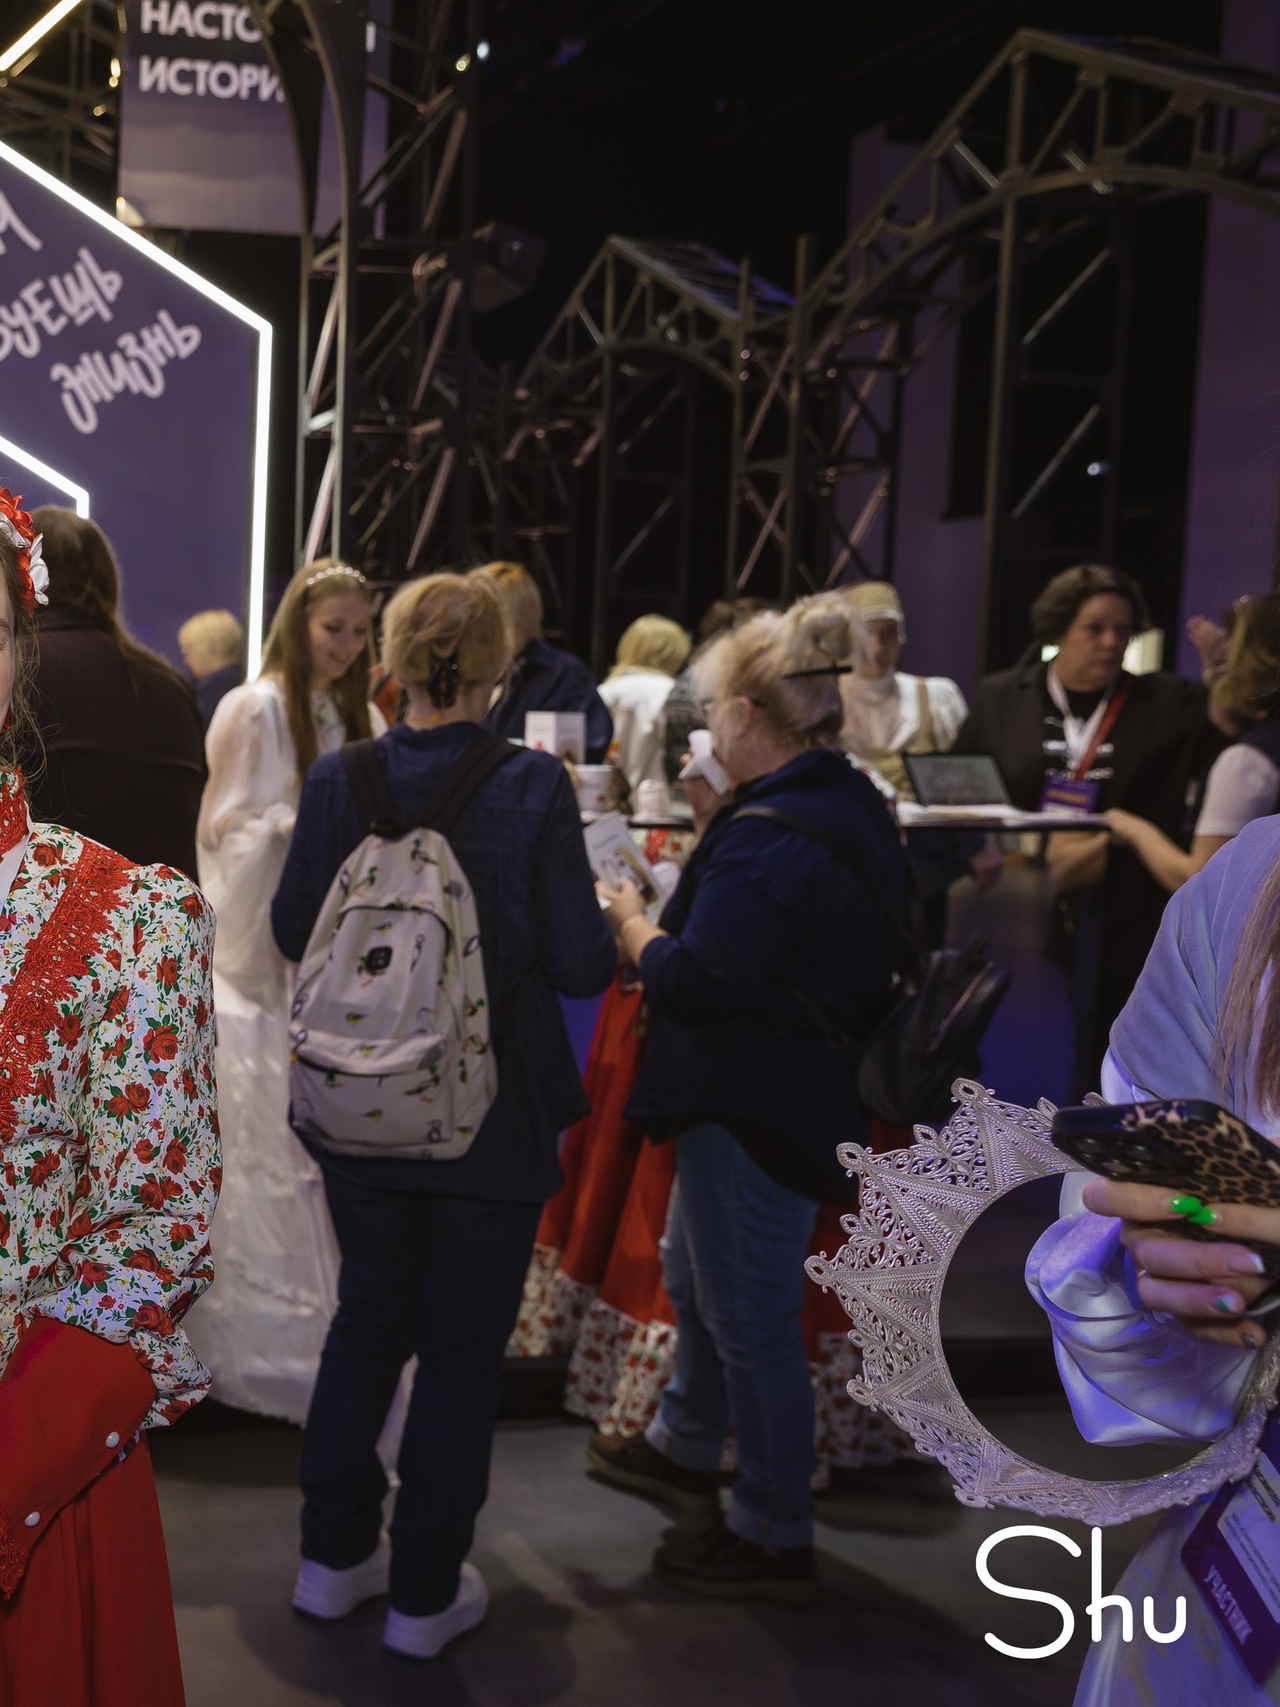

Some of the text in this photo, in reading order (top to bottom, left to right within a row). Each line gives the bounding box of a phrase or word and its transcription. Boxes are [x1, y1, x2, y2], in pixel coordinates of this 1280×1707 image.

[141, 0, 262, 43] НАСТО
[139, 54, 286, 102] ИСТОРИ
[1203, 1564, 1254, 1646] УЧАСТНИК
